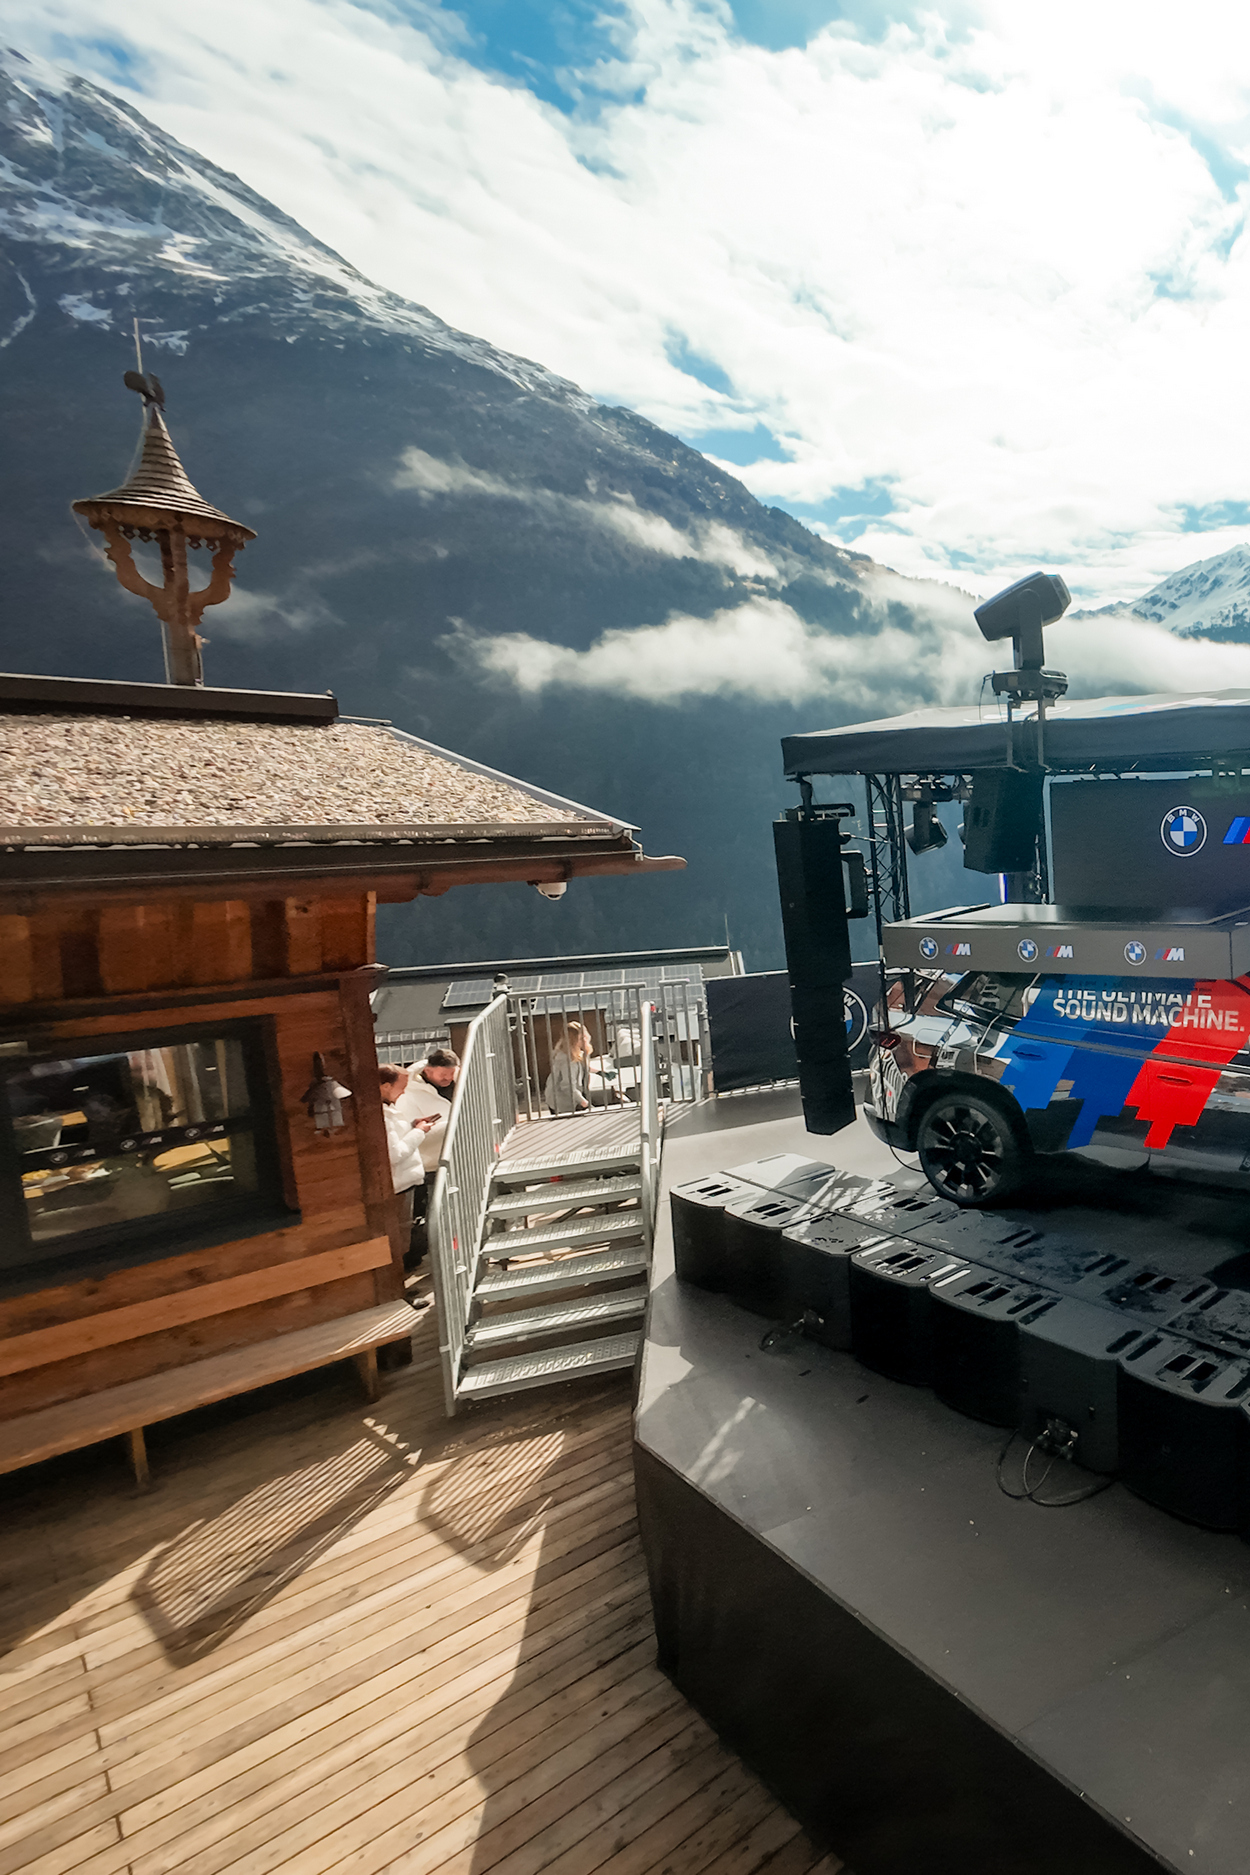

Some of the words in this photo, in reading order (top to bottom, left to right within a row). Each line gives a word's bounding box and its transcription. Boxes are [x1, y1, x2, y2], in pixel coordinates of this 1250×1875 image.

[1167, 809, 1200, 823] BMW
[1053, 999, 1127, 1023] SOUND
[1132, 1004, 1245, 1032] MACHINE.
